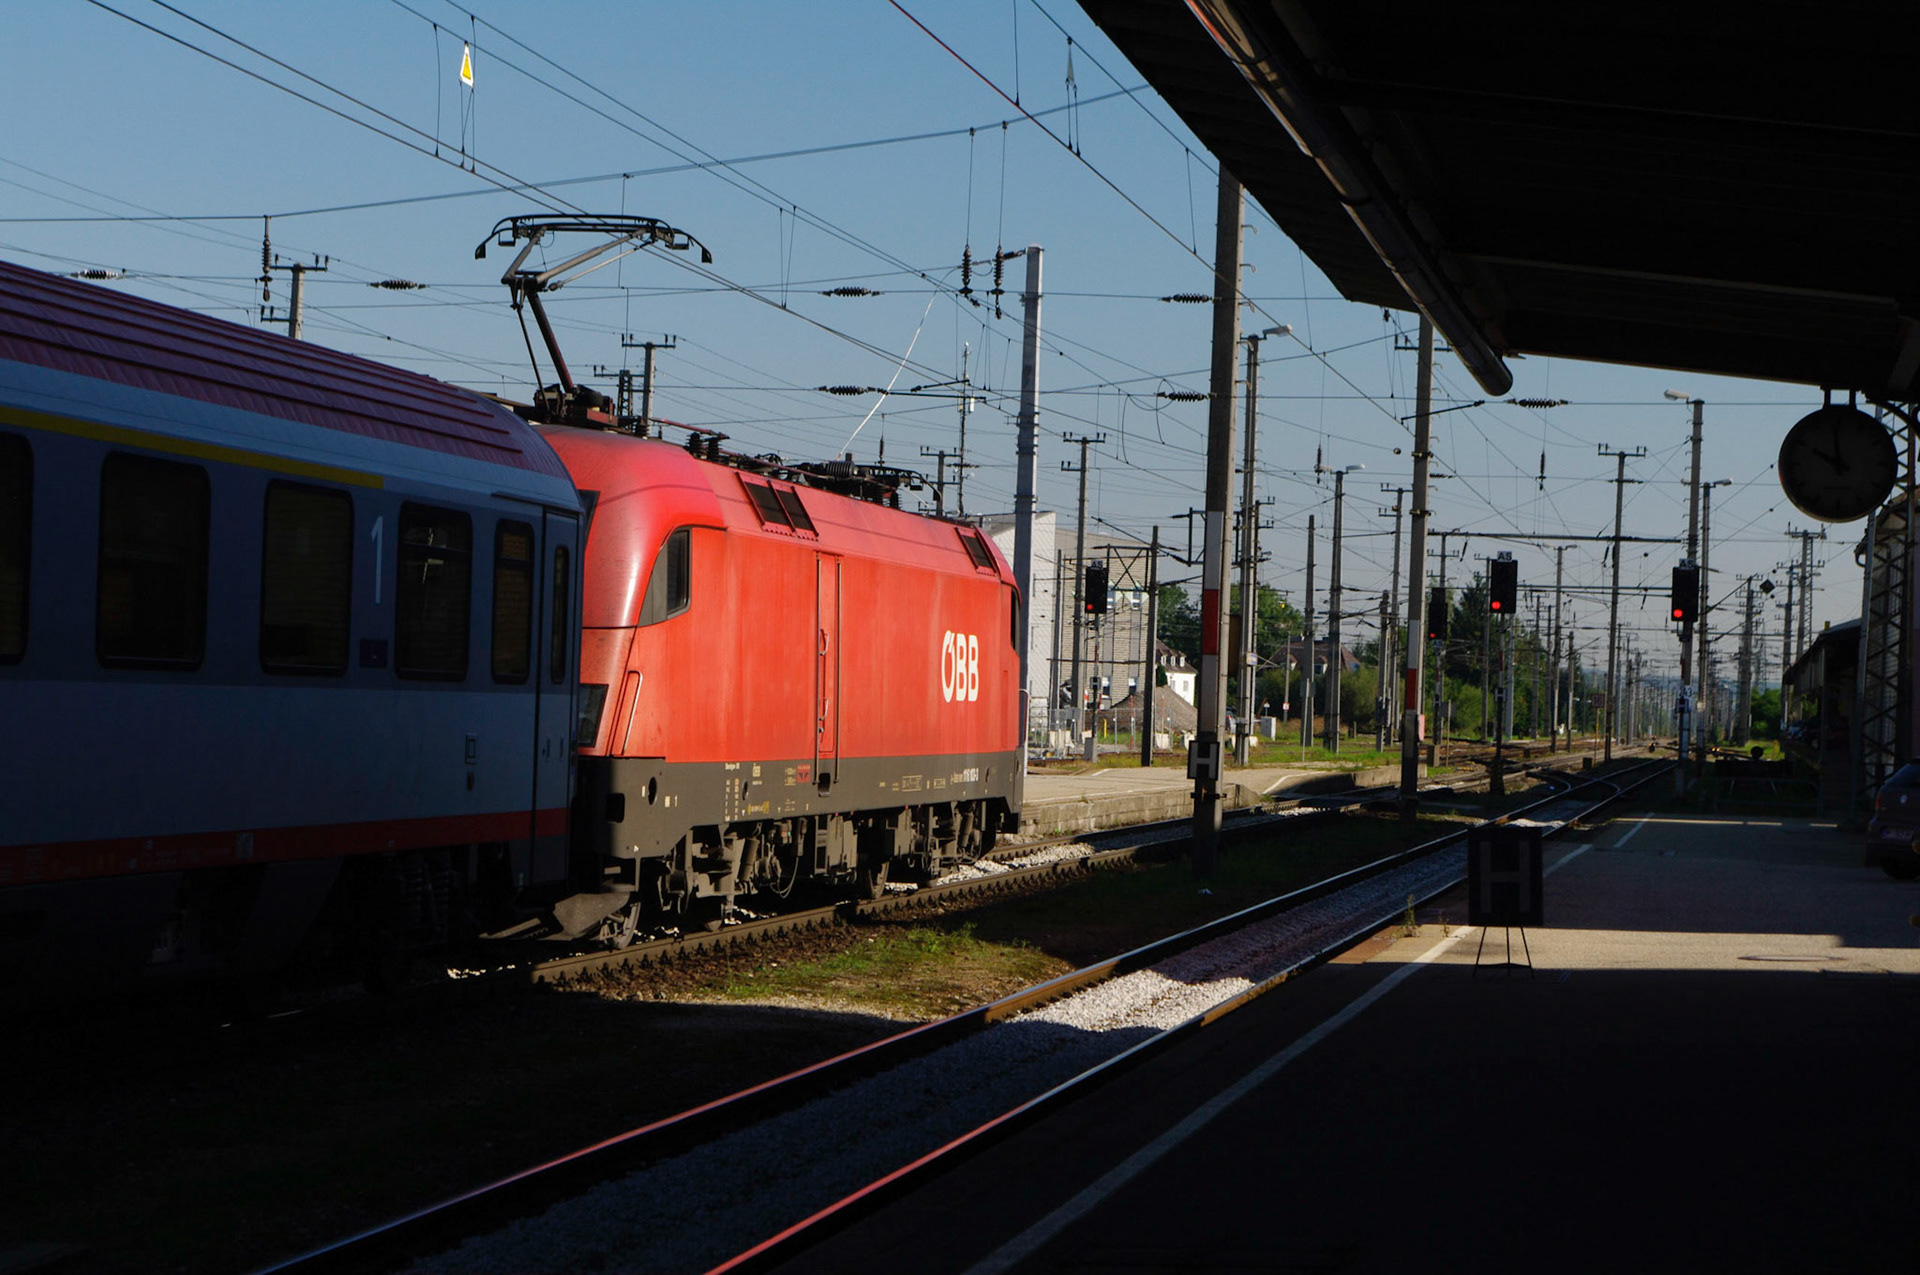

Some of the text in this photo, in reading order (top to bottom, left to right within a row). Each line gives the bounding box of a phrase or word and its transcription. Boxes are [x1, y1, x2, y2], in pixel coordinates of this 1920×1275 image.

[371, 515, 383, 605] 1
[1498, 551, 1512, 562] AS
[1680, 559, 1694, 568] AS
[1091, 560, 1103, 569] AS
[941, 630, 979, 703] ÖBB
[1090, 677, 1100, 690] H
[1494, 688, 1506, 702] H
[1189, 742, 1218, 779] H
[1479, 841, 1531, 914] H
